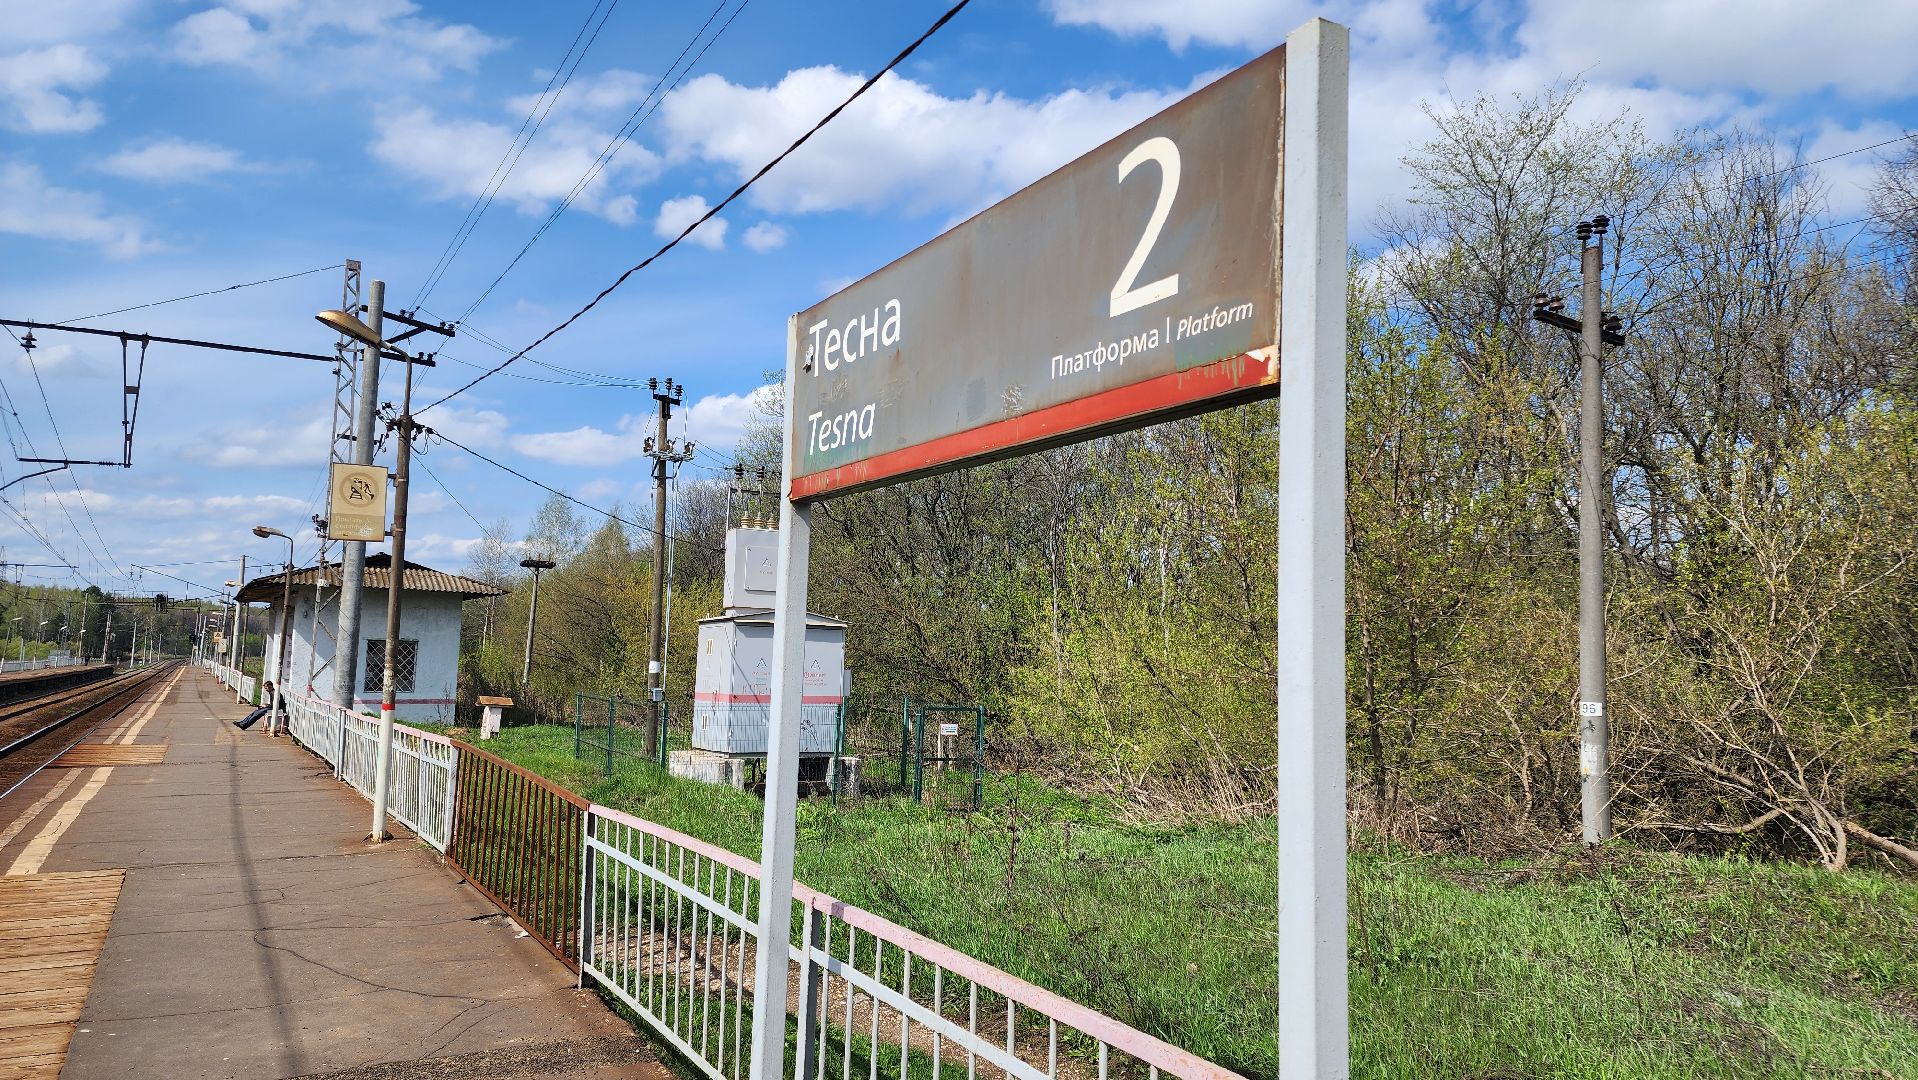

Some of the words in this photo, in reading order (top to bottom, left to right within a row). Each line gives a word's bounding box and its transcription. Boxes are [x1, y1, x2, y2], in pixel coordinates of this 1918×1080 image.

[1109, 136, 1182, 318] 2
[808, 298, 901, 378] Тесна
[1051, 328, 1160, 380] Платформа
[1176, 301, 1254, 342] Platform
[808, 402, 876, 456] Tesna
[1582, 703, 1596, 714] 96
